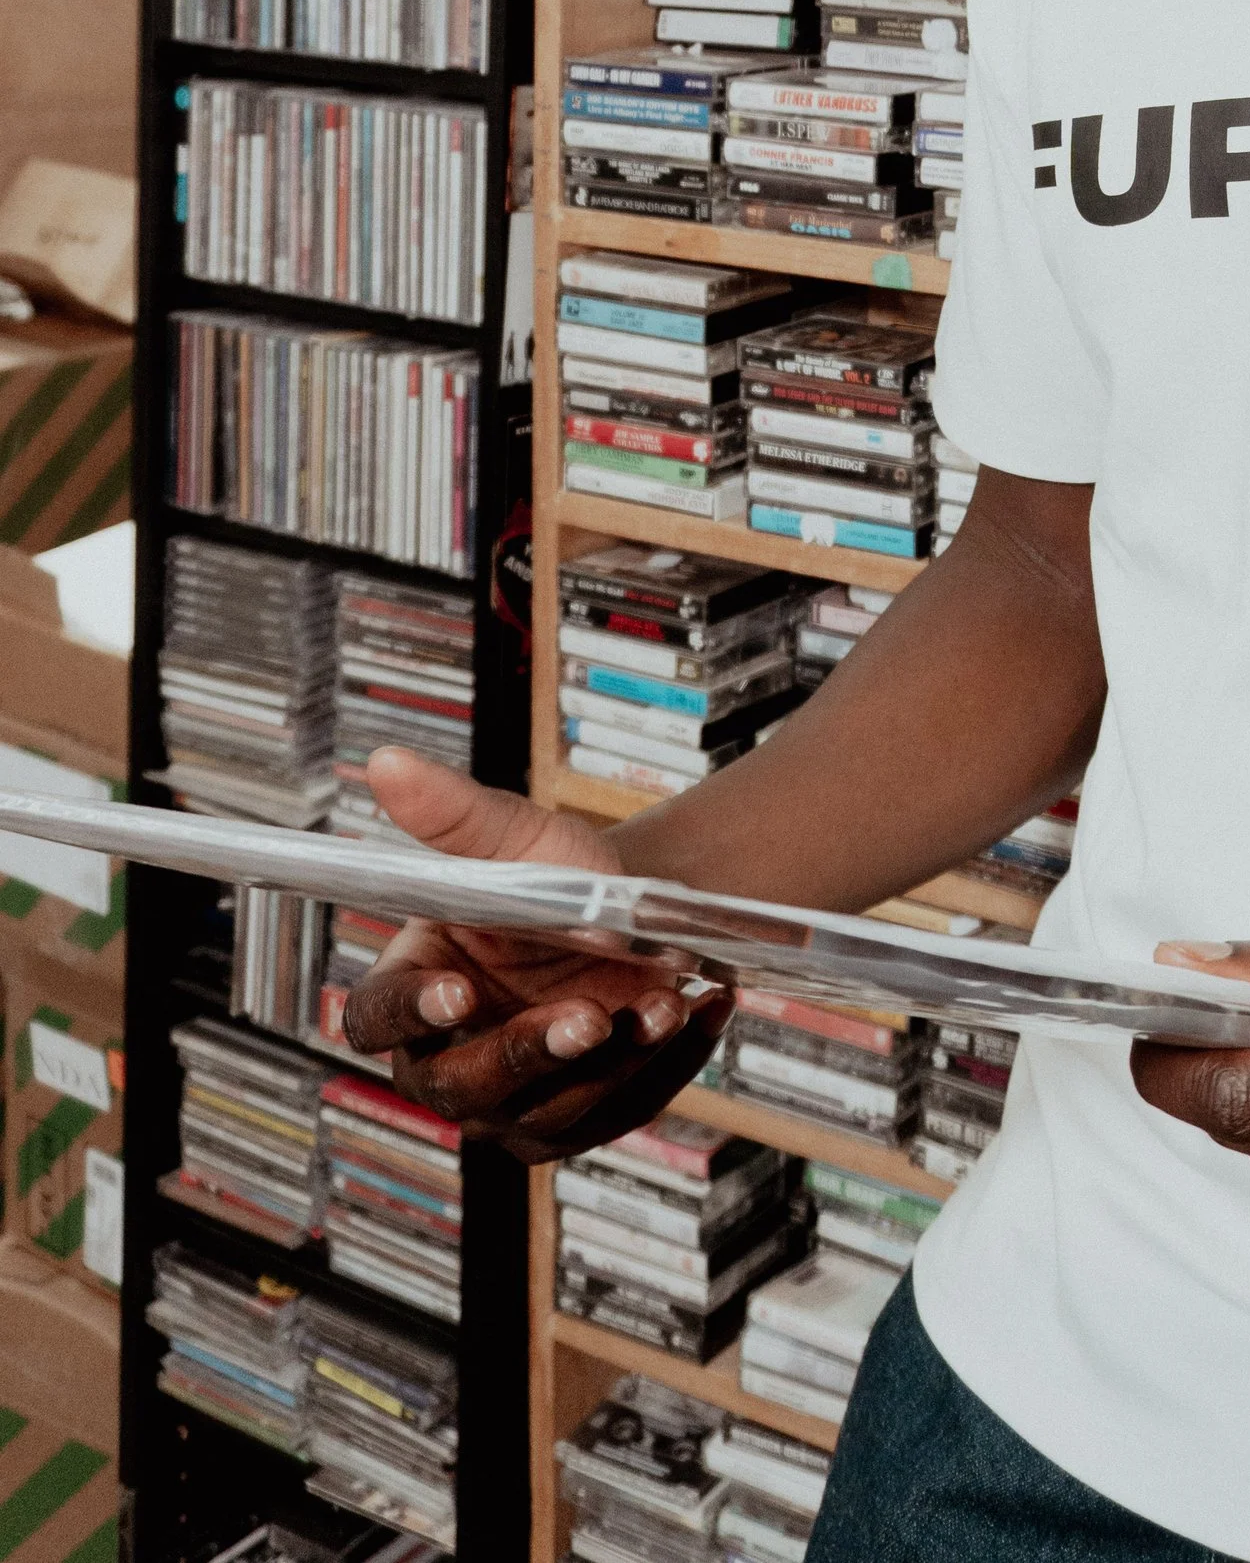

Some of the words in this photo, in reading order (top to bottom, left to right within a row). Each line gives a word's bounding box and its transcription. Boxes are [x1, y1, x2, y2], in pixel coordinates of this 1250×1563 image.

[774, 89, 813, 107] LUTHER
[817, 93, 880, 114] VANDROSS
[750, 146, 787, 162] CONNIE
[790, 151, 835, 168] FRANCIS
[613, 438, 664, 454] COLLECTION
[629, 430, 661, 443] SAMPLE
[758, 443, 803, 462] MELISSA
[804, 451, 867, 473] ETHERIDGE
